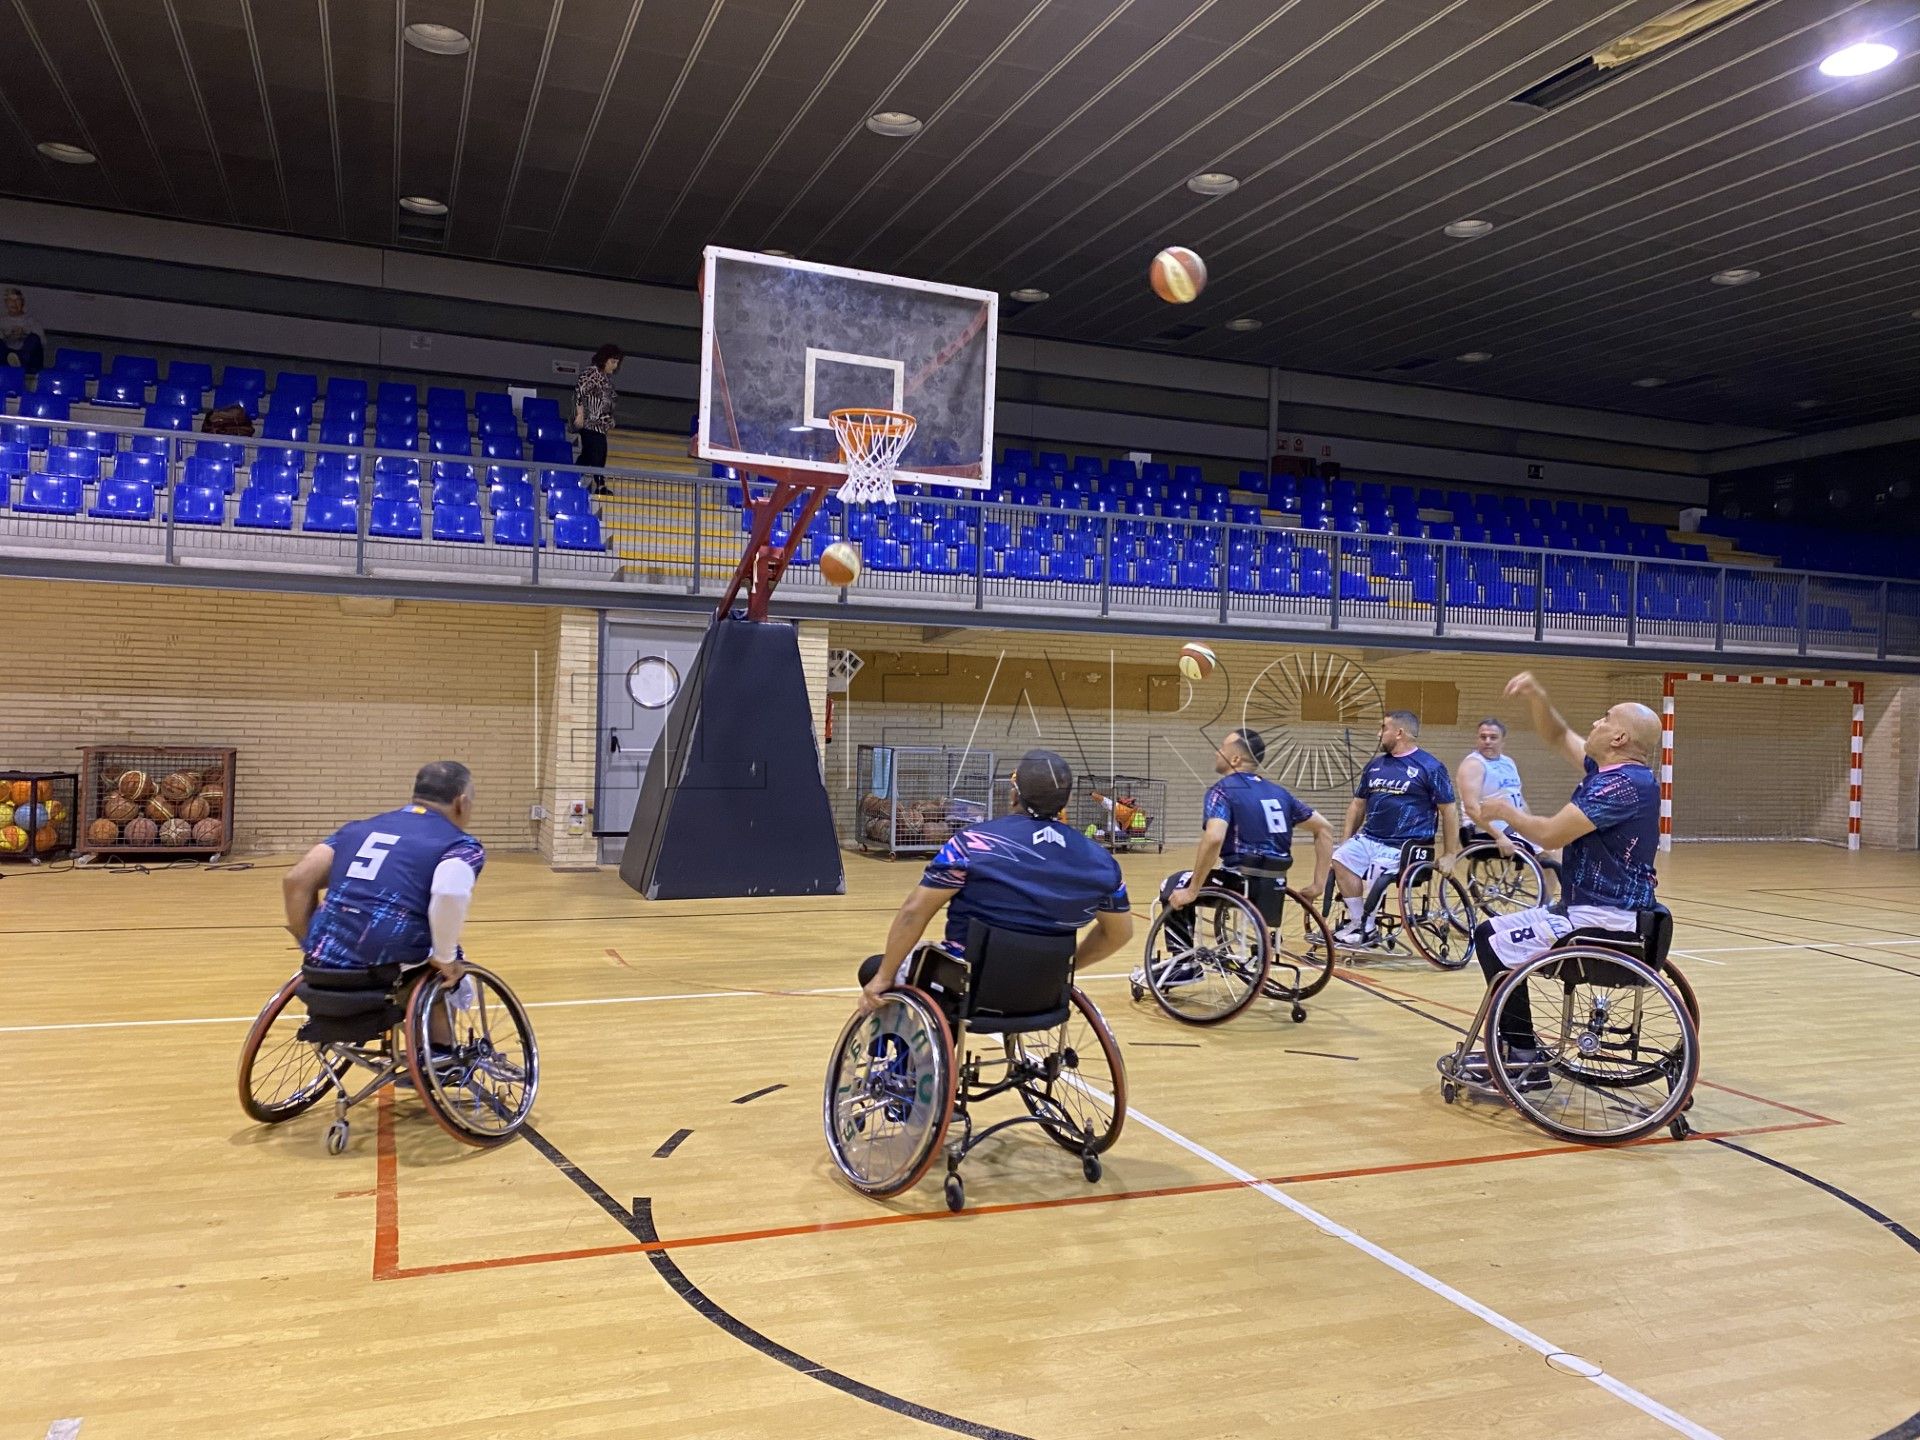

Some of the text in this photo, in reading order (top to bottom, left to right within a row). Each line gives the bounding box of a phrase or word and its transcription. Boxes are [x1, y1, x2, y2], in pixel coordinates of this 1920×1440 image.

[1260, 799, 1288, 834] 6
[345, 831, 401, 881] 5
[1415, 848, 1427, 860] 13
